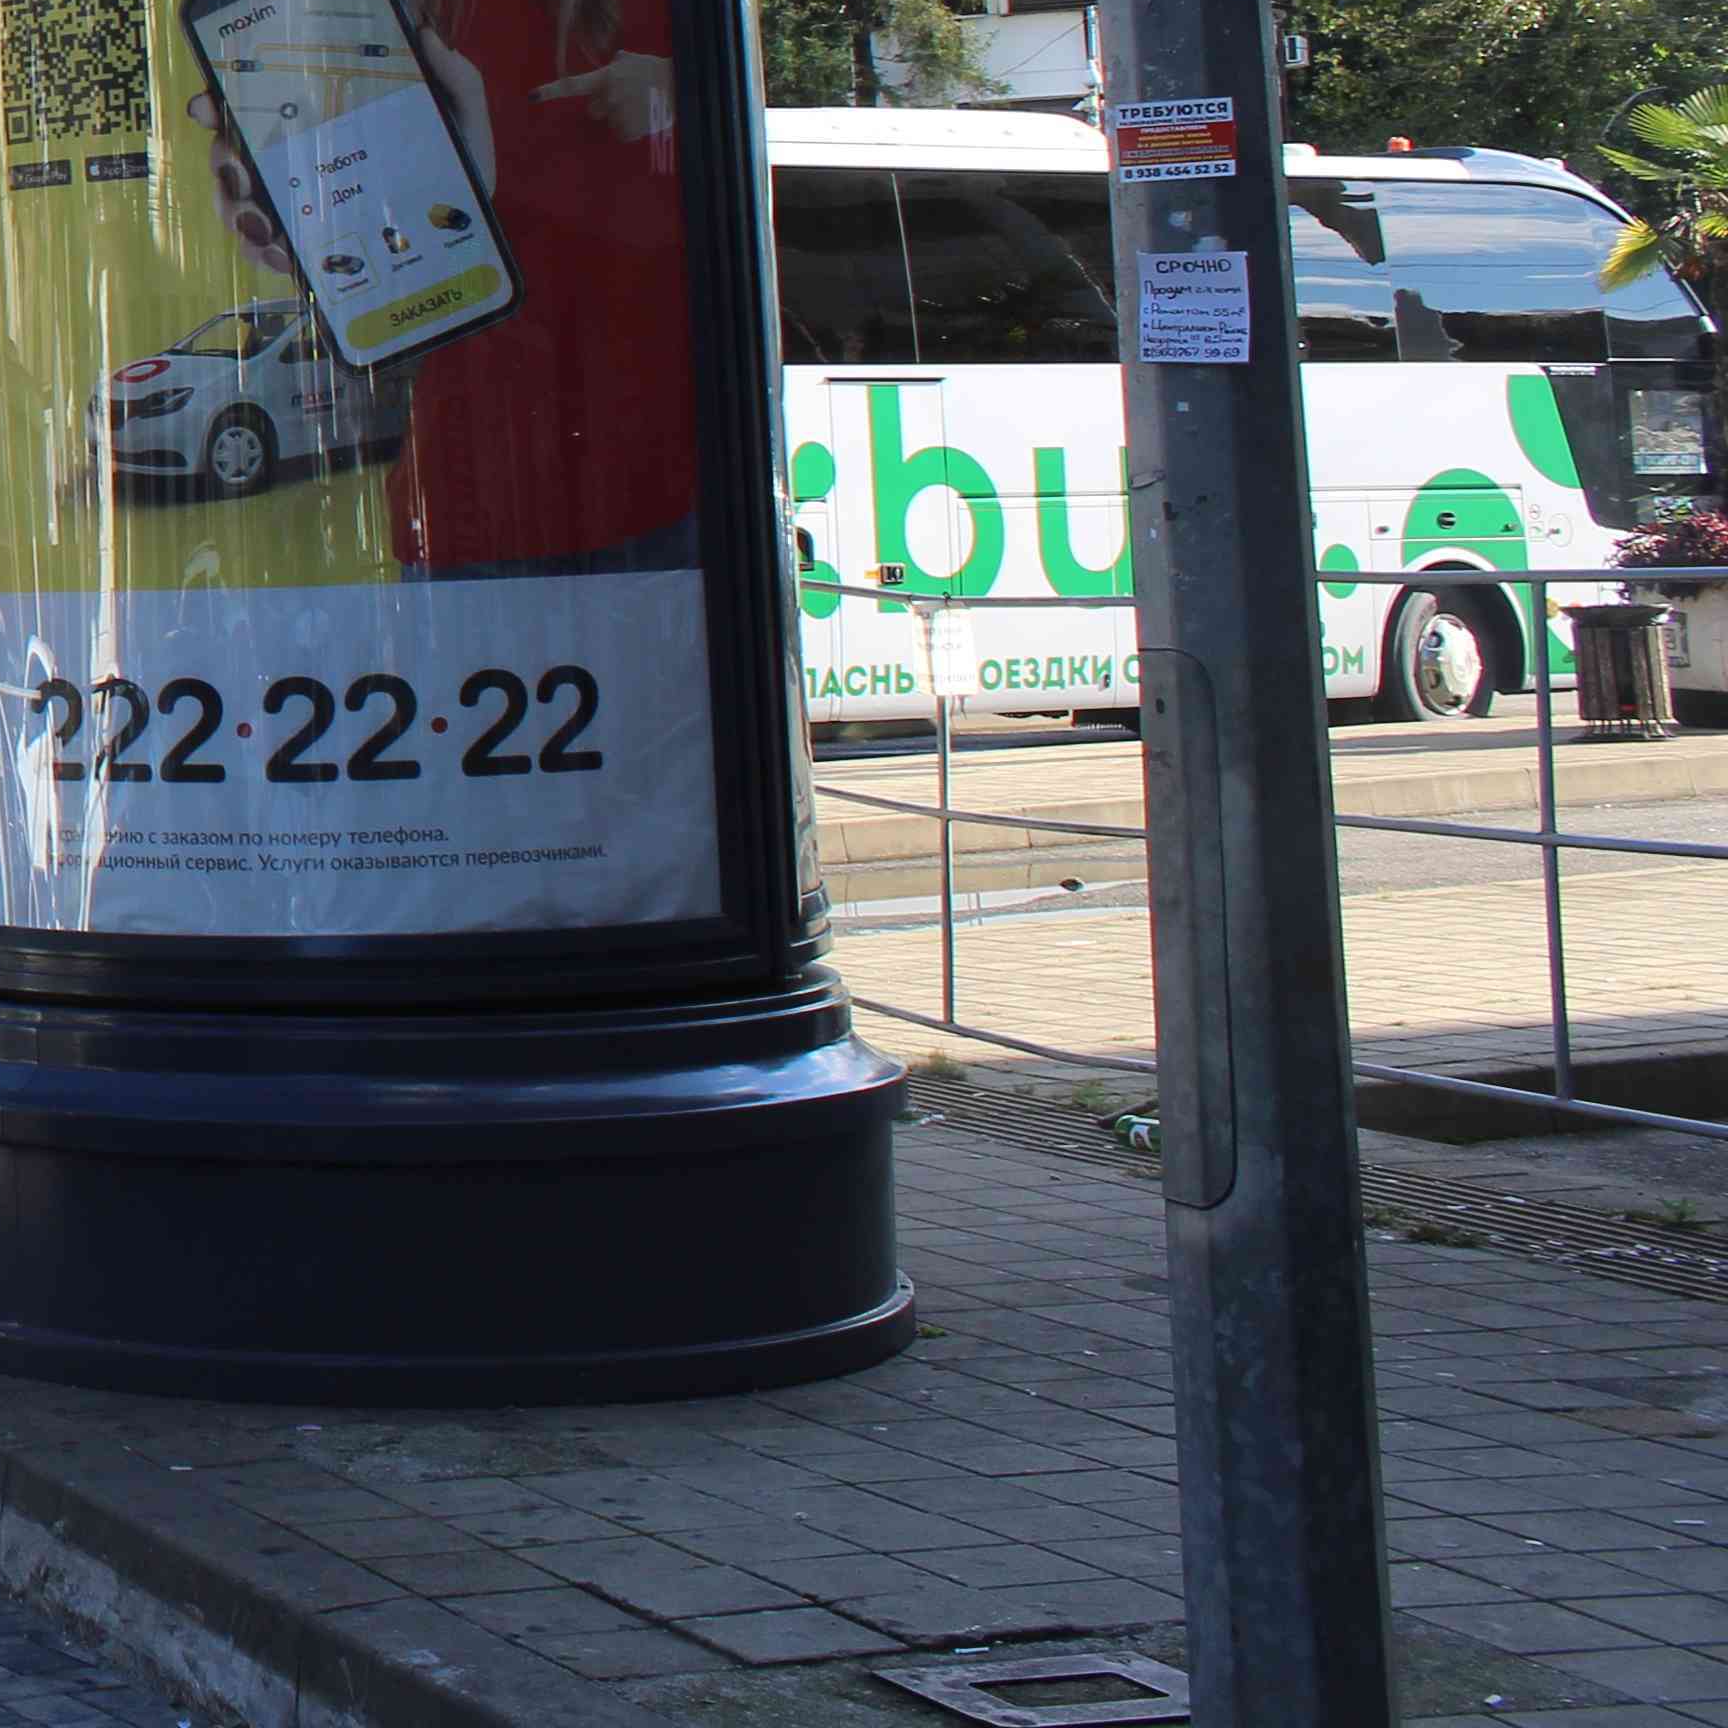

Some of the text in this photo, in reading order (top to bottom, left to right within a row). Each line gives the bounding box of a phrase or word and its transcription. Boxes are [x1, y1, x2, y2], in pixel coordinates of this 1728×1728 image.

[218, 4, 276, 38] maxim
[1119, 102, 1228, 120] ТРЕБУЮТСЯ
[315, 149, 368, 177] Работа
[1136, 167, 1160, 178] 938
[1166, 165, 1191, 176] 454
[1194, 164, 1209, 174] 52
[1214, 163, 1229, 173] 52
[331, 183, 363, 207] Дом
[1155, 258, 1232, 274] СРОЧНО
[389, 287, 463, 328] ЗАКАЗАТЬ
[979, 656, 1113, 690] ОЕЗДКИ
[148, 832, 157, 844] с
[161, 831, 233, 845] заказом
[239, 830, 262, 846] по
[269, 829, 341, 849] номеру
[349, 825, 449, 849] телефона.
[184, 856, 253, 874] сервис.
[259, 853, 324, 874] Услуги
[331, 852, 459, 872] оказываются
[465, 843, 608, 867] перевозчиками.
